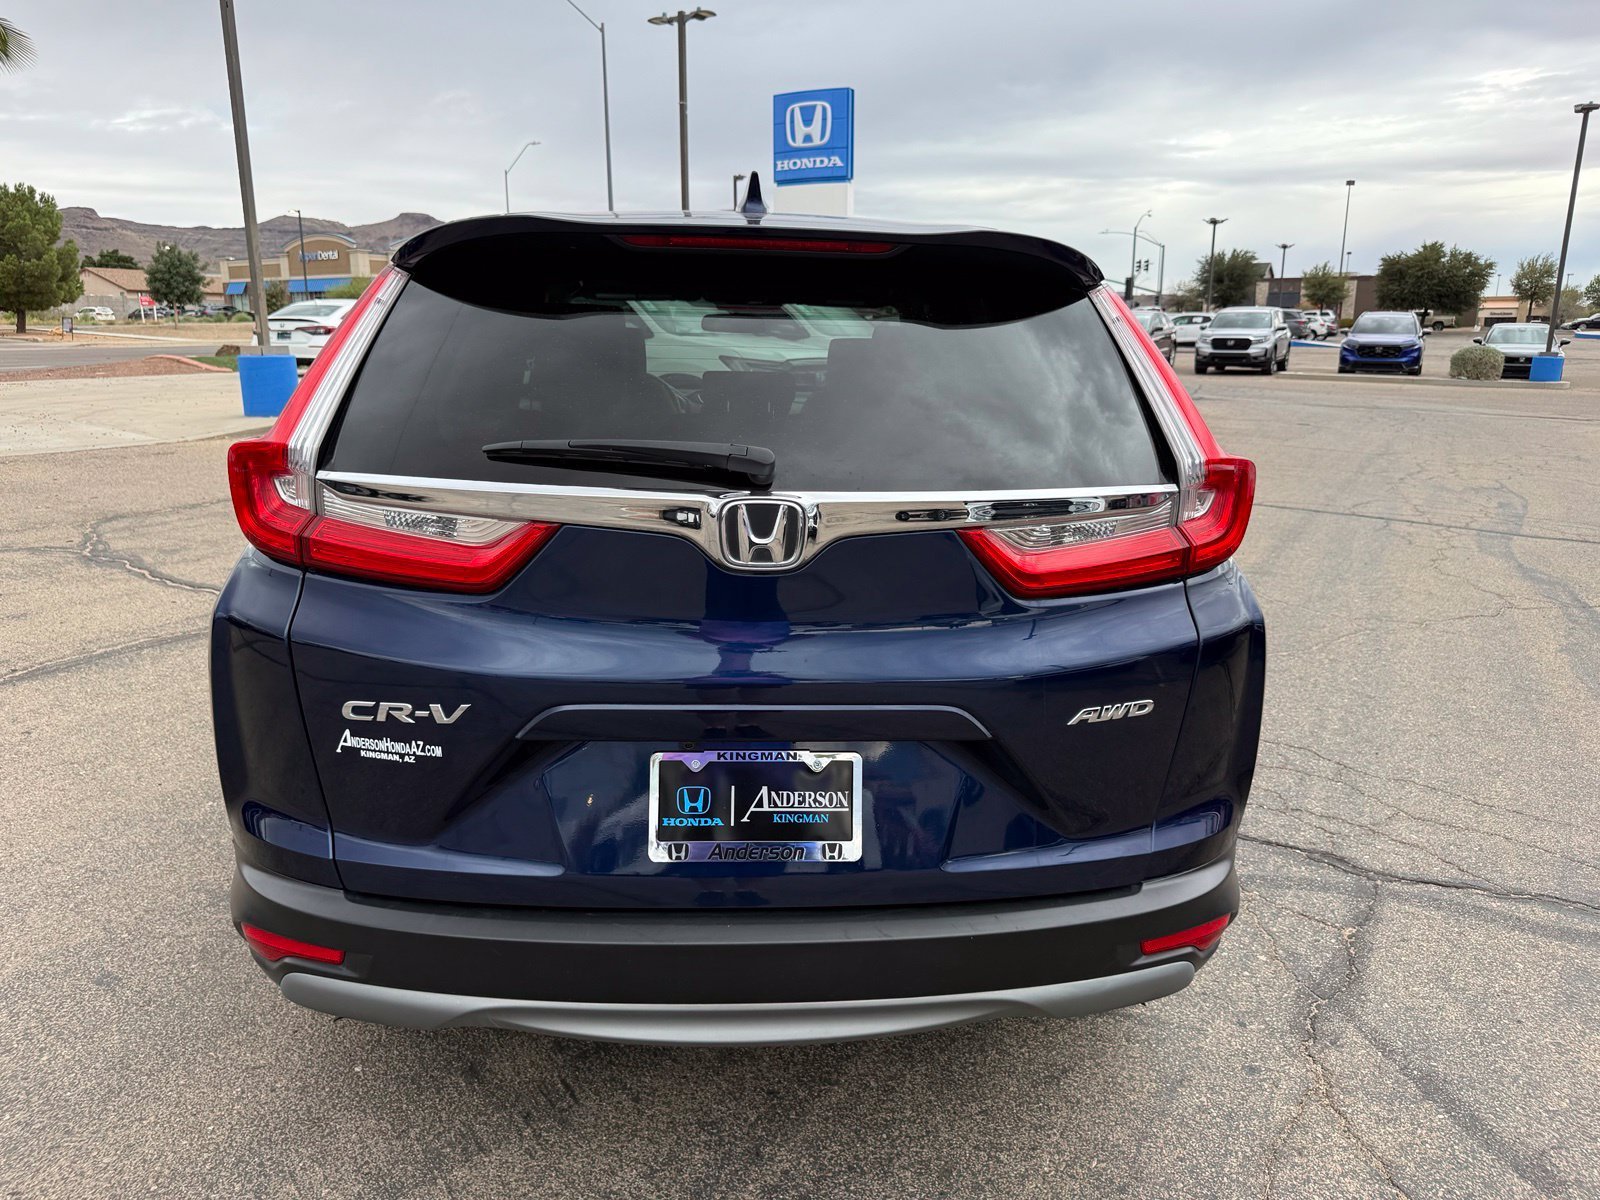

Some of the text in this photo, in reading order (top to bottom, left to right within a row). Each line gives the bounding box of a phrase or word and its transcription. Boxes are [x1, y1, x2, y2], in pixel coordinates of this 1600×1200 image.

[776, 156, 844, 171] HONDA
[341, 700, 472, 724] CR-V
[1067, 699, 1155, 725] AWD
[360, 749, 416, 763] KINGMAN, AZ
[716, 751, 798, 761] KINGMAN
[740, 785, 849, 822] ANDERSON
[662, 817, 724, 827] HONDA
[773, 813, 829, 823] KINGMAN
[708, 843, 806, 861] Anderson
